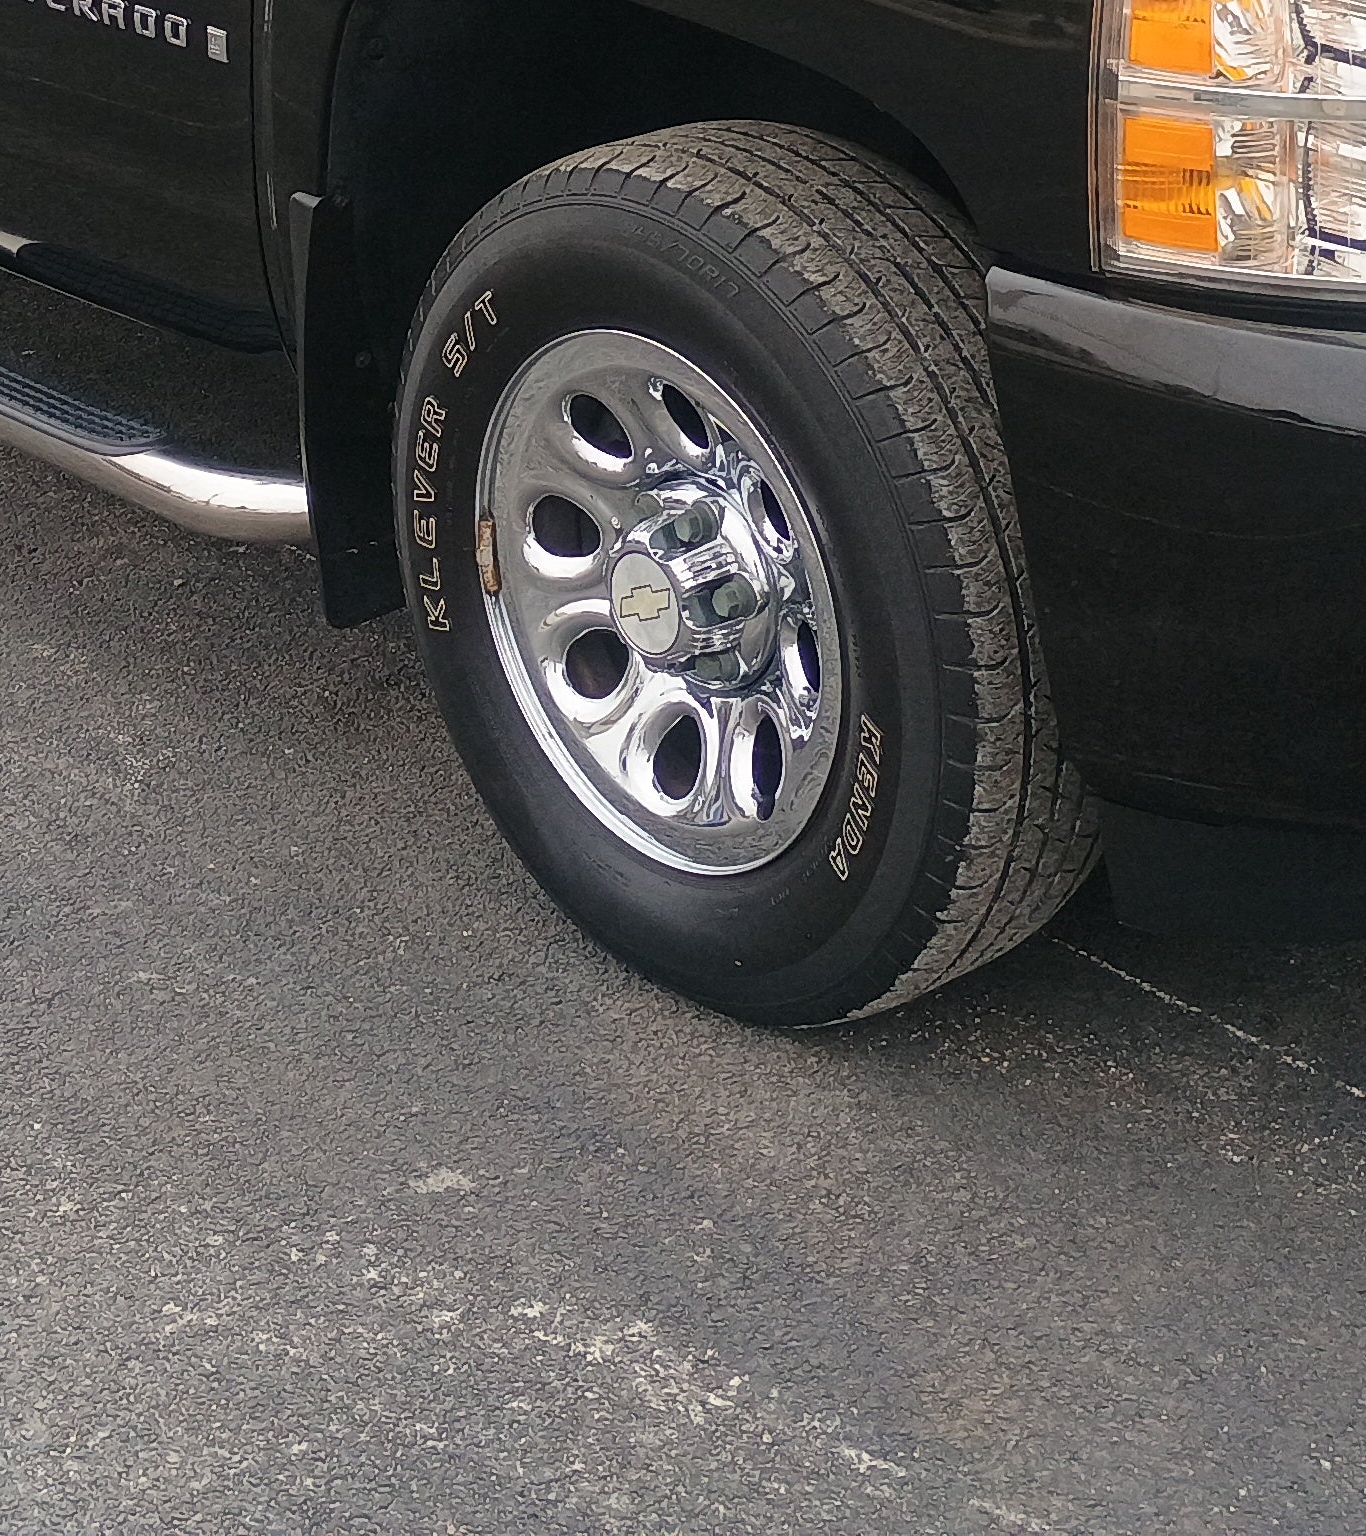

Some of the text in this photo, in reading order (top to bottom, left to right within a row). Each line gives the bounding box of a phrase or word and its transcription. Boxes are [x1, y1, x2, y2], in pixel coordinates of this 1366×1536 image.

[413, 290, 498, 632] KLEVER S/T
[829, 712, 884, 881] KENDA
